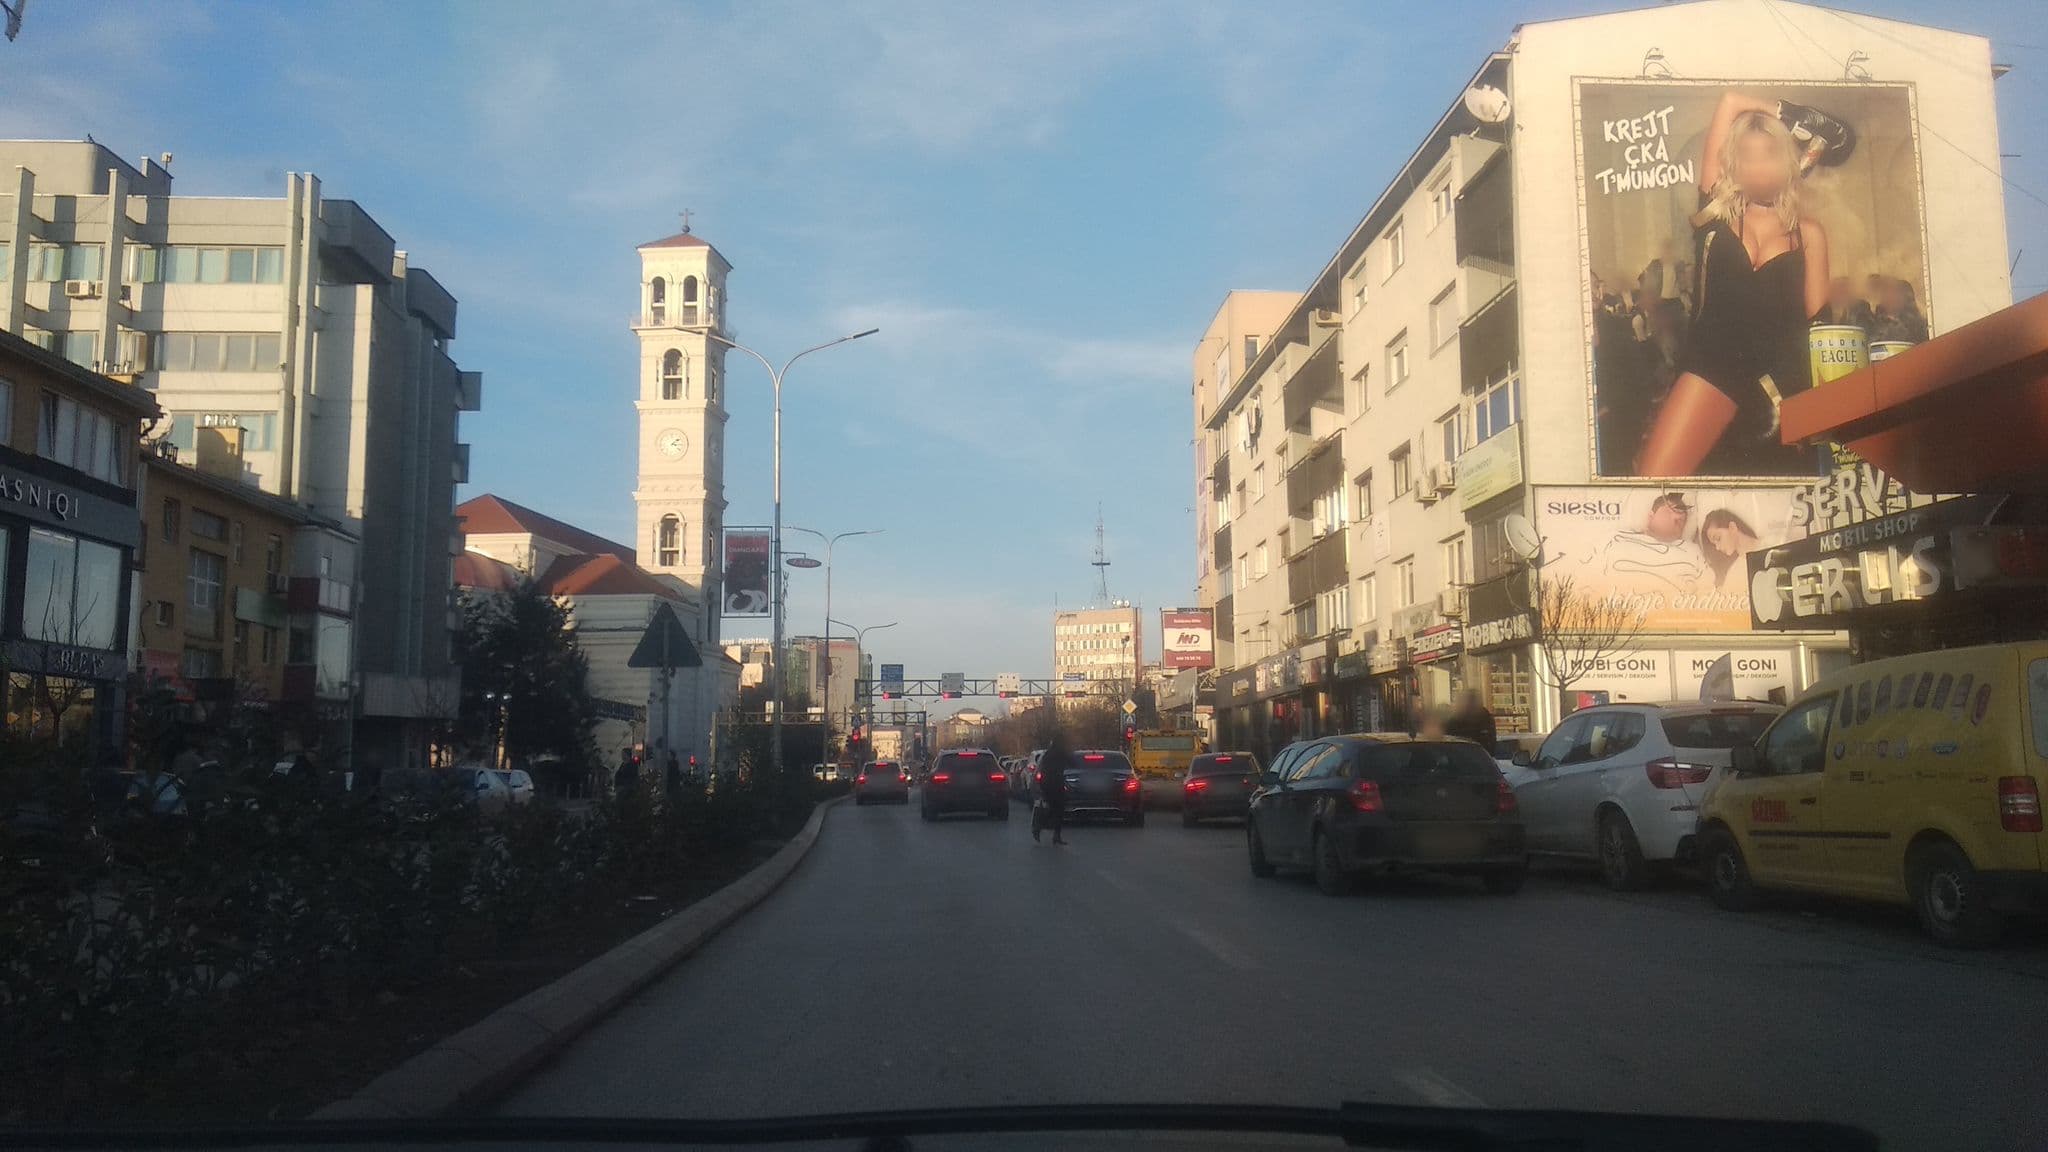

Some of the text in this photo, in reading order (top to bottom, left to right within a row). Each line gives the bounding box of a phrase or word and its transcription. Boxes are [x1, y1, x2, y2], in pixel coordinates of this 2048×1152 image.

[1603, 105, 1674, 143] KREJT
[1624, 135, 1669, 170] ÇKA
[1821, 349, 1857, 363] EAGLE
[1547, 499, 1621, 516] siesta
[1820, 513, 1920, 551] MOBIL SHOP
[1571, 659, 1656, 671] MOBI GONI
[1737, 659, 1777, 671] GONI
